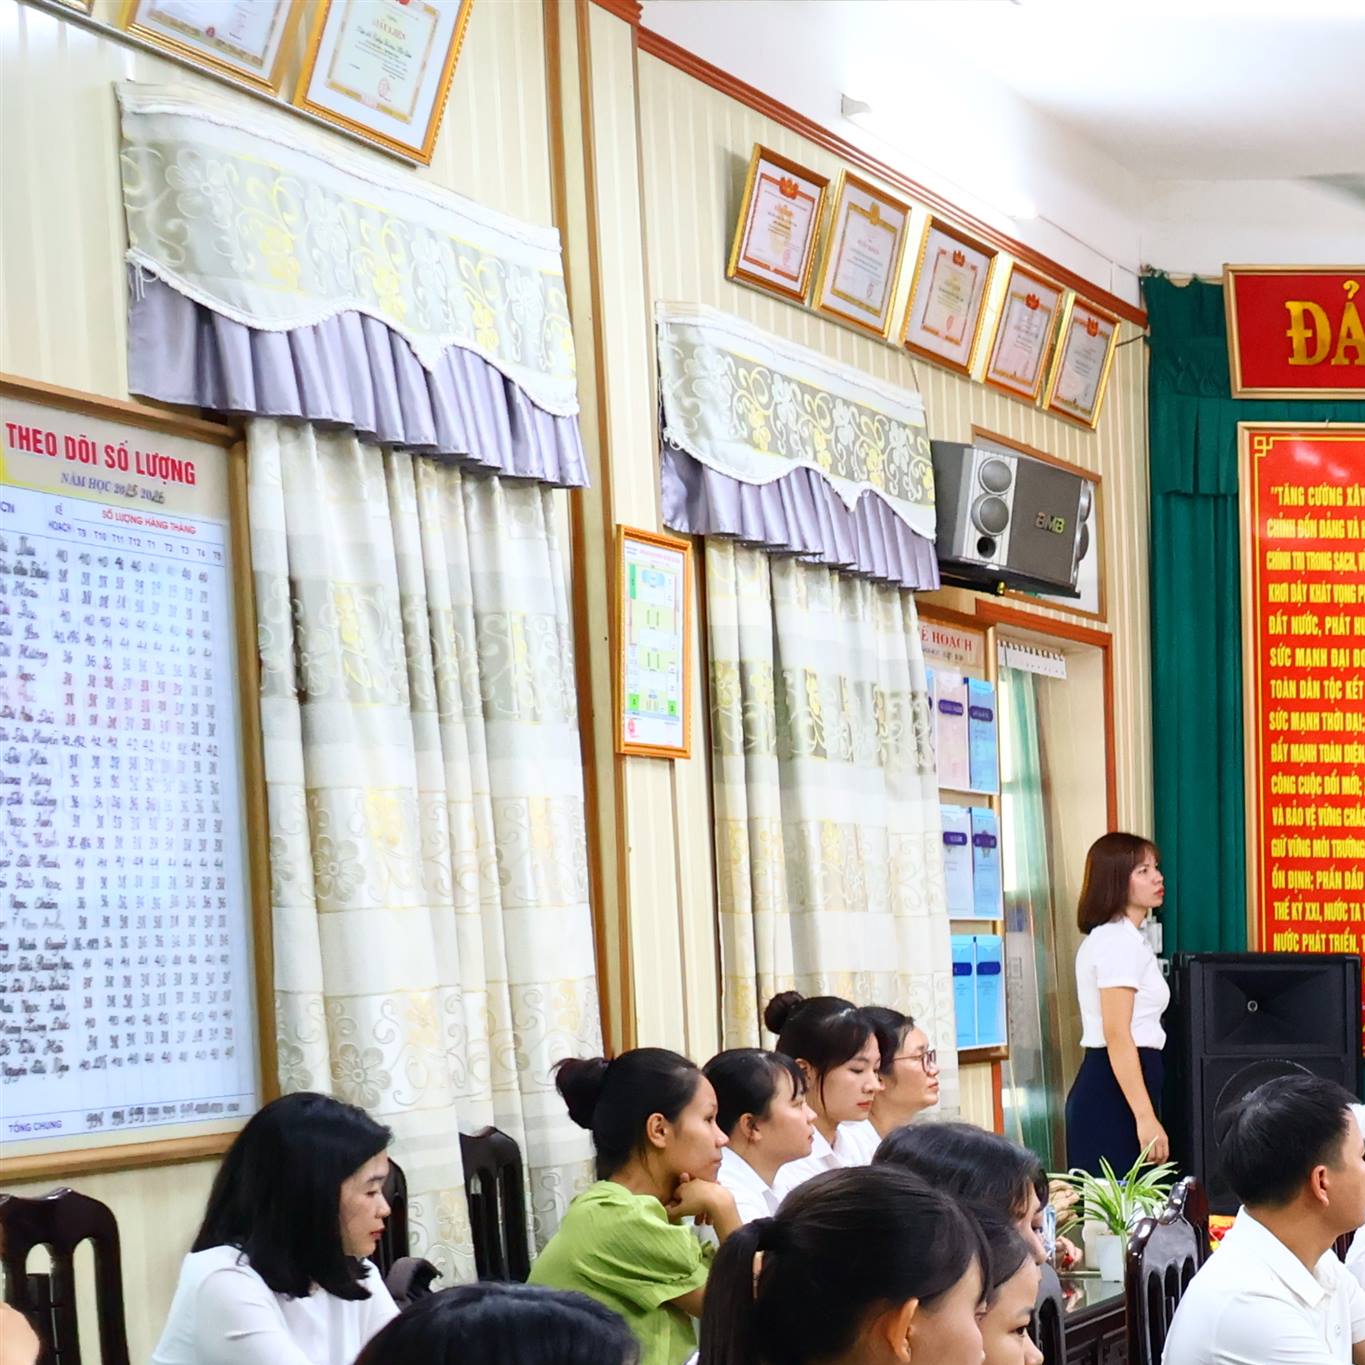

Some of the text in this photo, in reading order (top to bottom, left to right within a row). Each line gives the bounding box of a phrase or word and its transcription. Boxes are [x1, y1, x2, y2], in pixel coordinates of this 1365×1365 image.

[6, 423, 196, 484] THEO DÕI SỐ LƯỢNG
[1036, 512, 1065, 535] BMB
[1270, 642, 1291, 667] SỨC
[1295, 648, 1327, 671] MẠNH
[1331, 648, 1349, 671] ĐẠI
[1270, 676, 1296, 699] TOÀN
[1300, 676, 1320, 699] DÂN
[1323, 676, 1342, 704] TỘC
[1346, 675, 1364, 699] KẾT
[1274, 928, 1299, 952] NƯỚC
[1302, 930, 1326, 952] PHÁT
